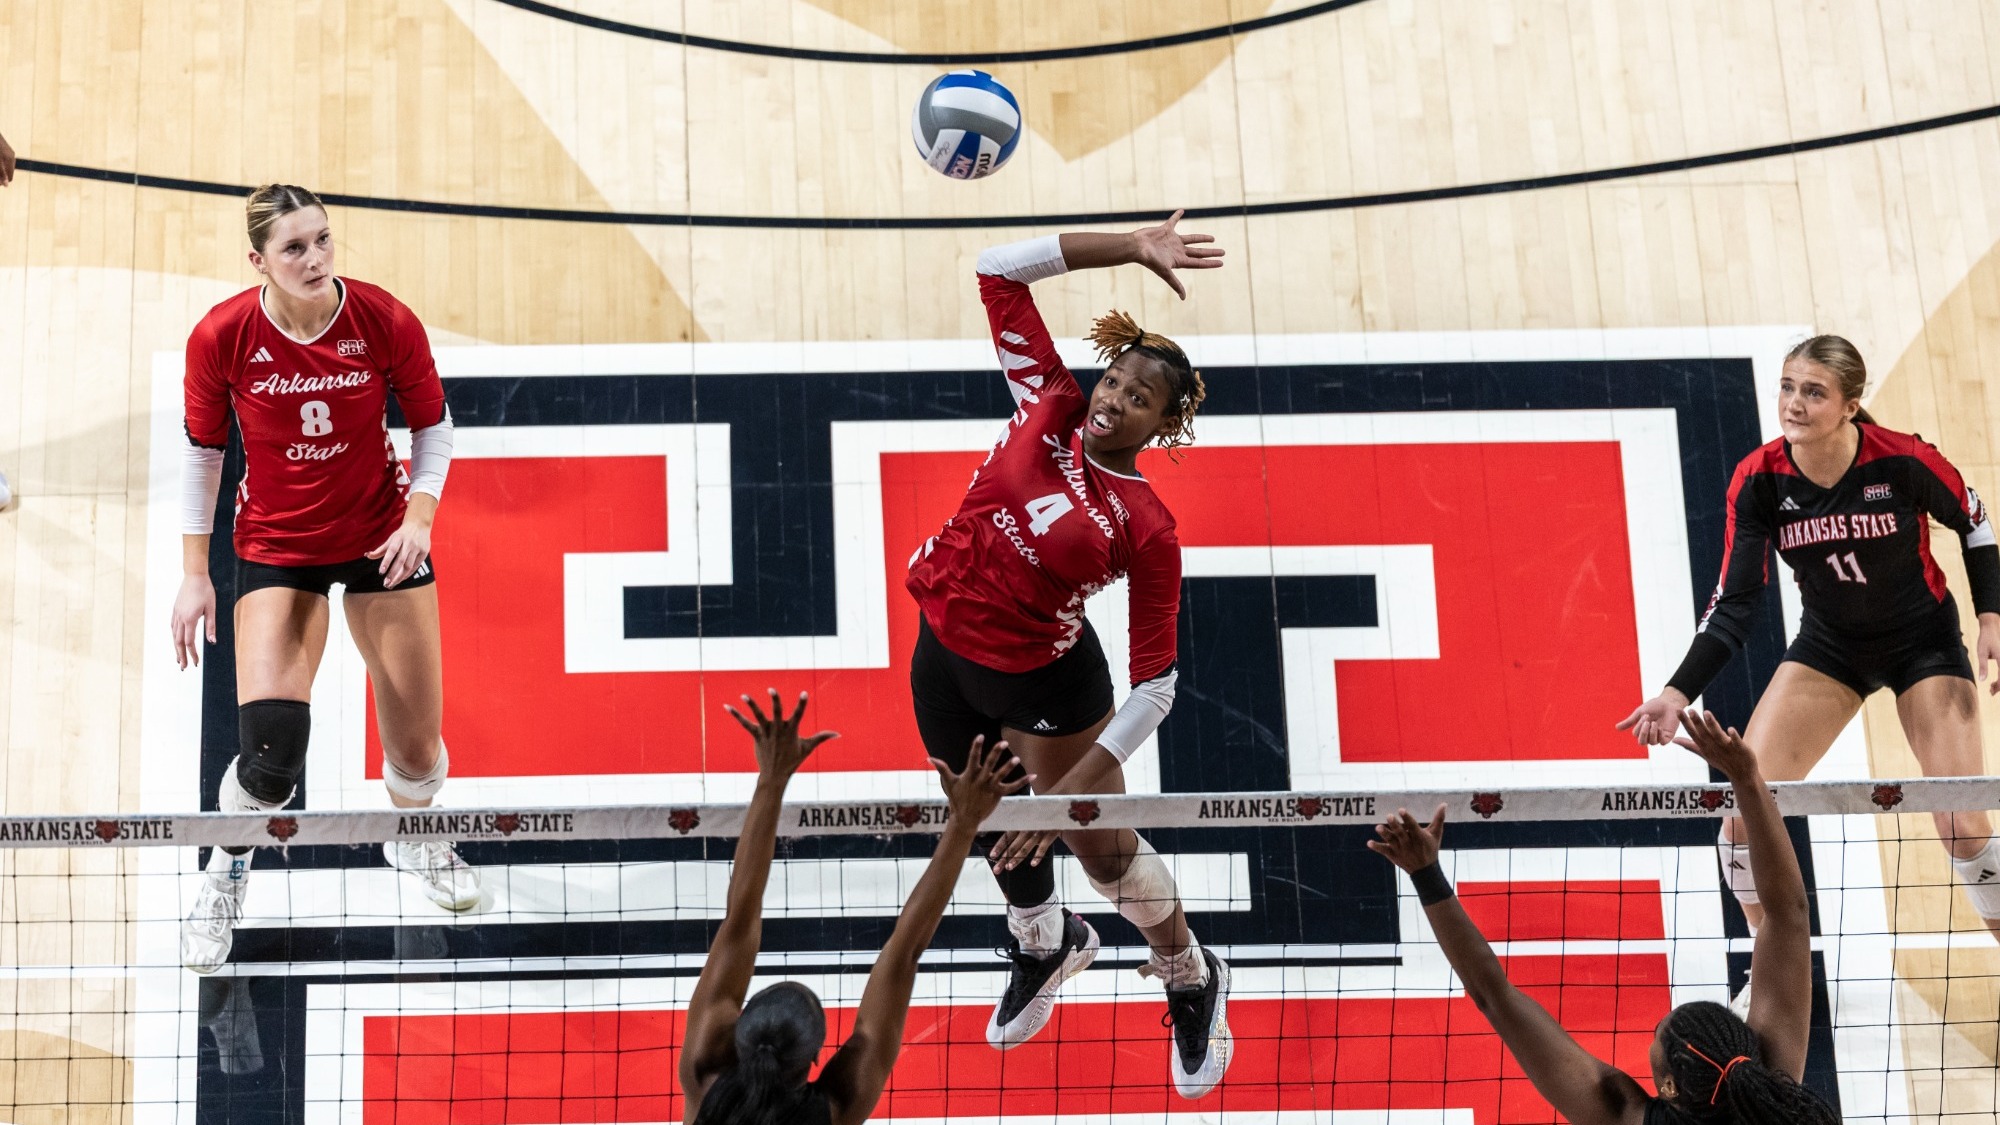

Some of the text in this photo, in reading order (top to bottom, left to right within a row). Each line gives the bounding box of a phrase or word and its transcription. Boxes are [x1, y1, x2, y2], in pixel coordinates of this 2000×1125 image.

[250, 371, 371, 395] Arkansas
[300, 400, 333, 437] 8
[1864, 484, 1892, 500] SBC
[1024, 492, 1074, 537] 4
[1780, 512, 1898, 550] ARKANSAS STATE
[1826, 551, 1867, 585] 11
[1198, 797, 1376, 818] ARKANSAS STATE
[1601, 791, 1699, 811] ARKANSAS
[397, 814, 573, 834] ARKANSAS STATE
[798, 806, 950, 827] ARKANSAS STA
[0, 820, 173, 841] ARKANSAS STATE
